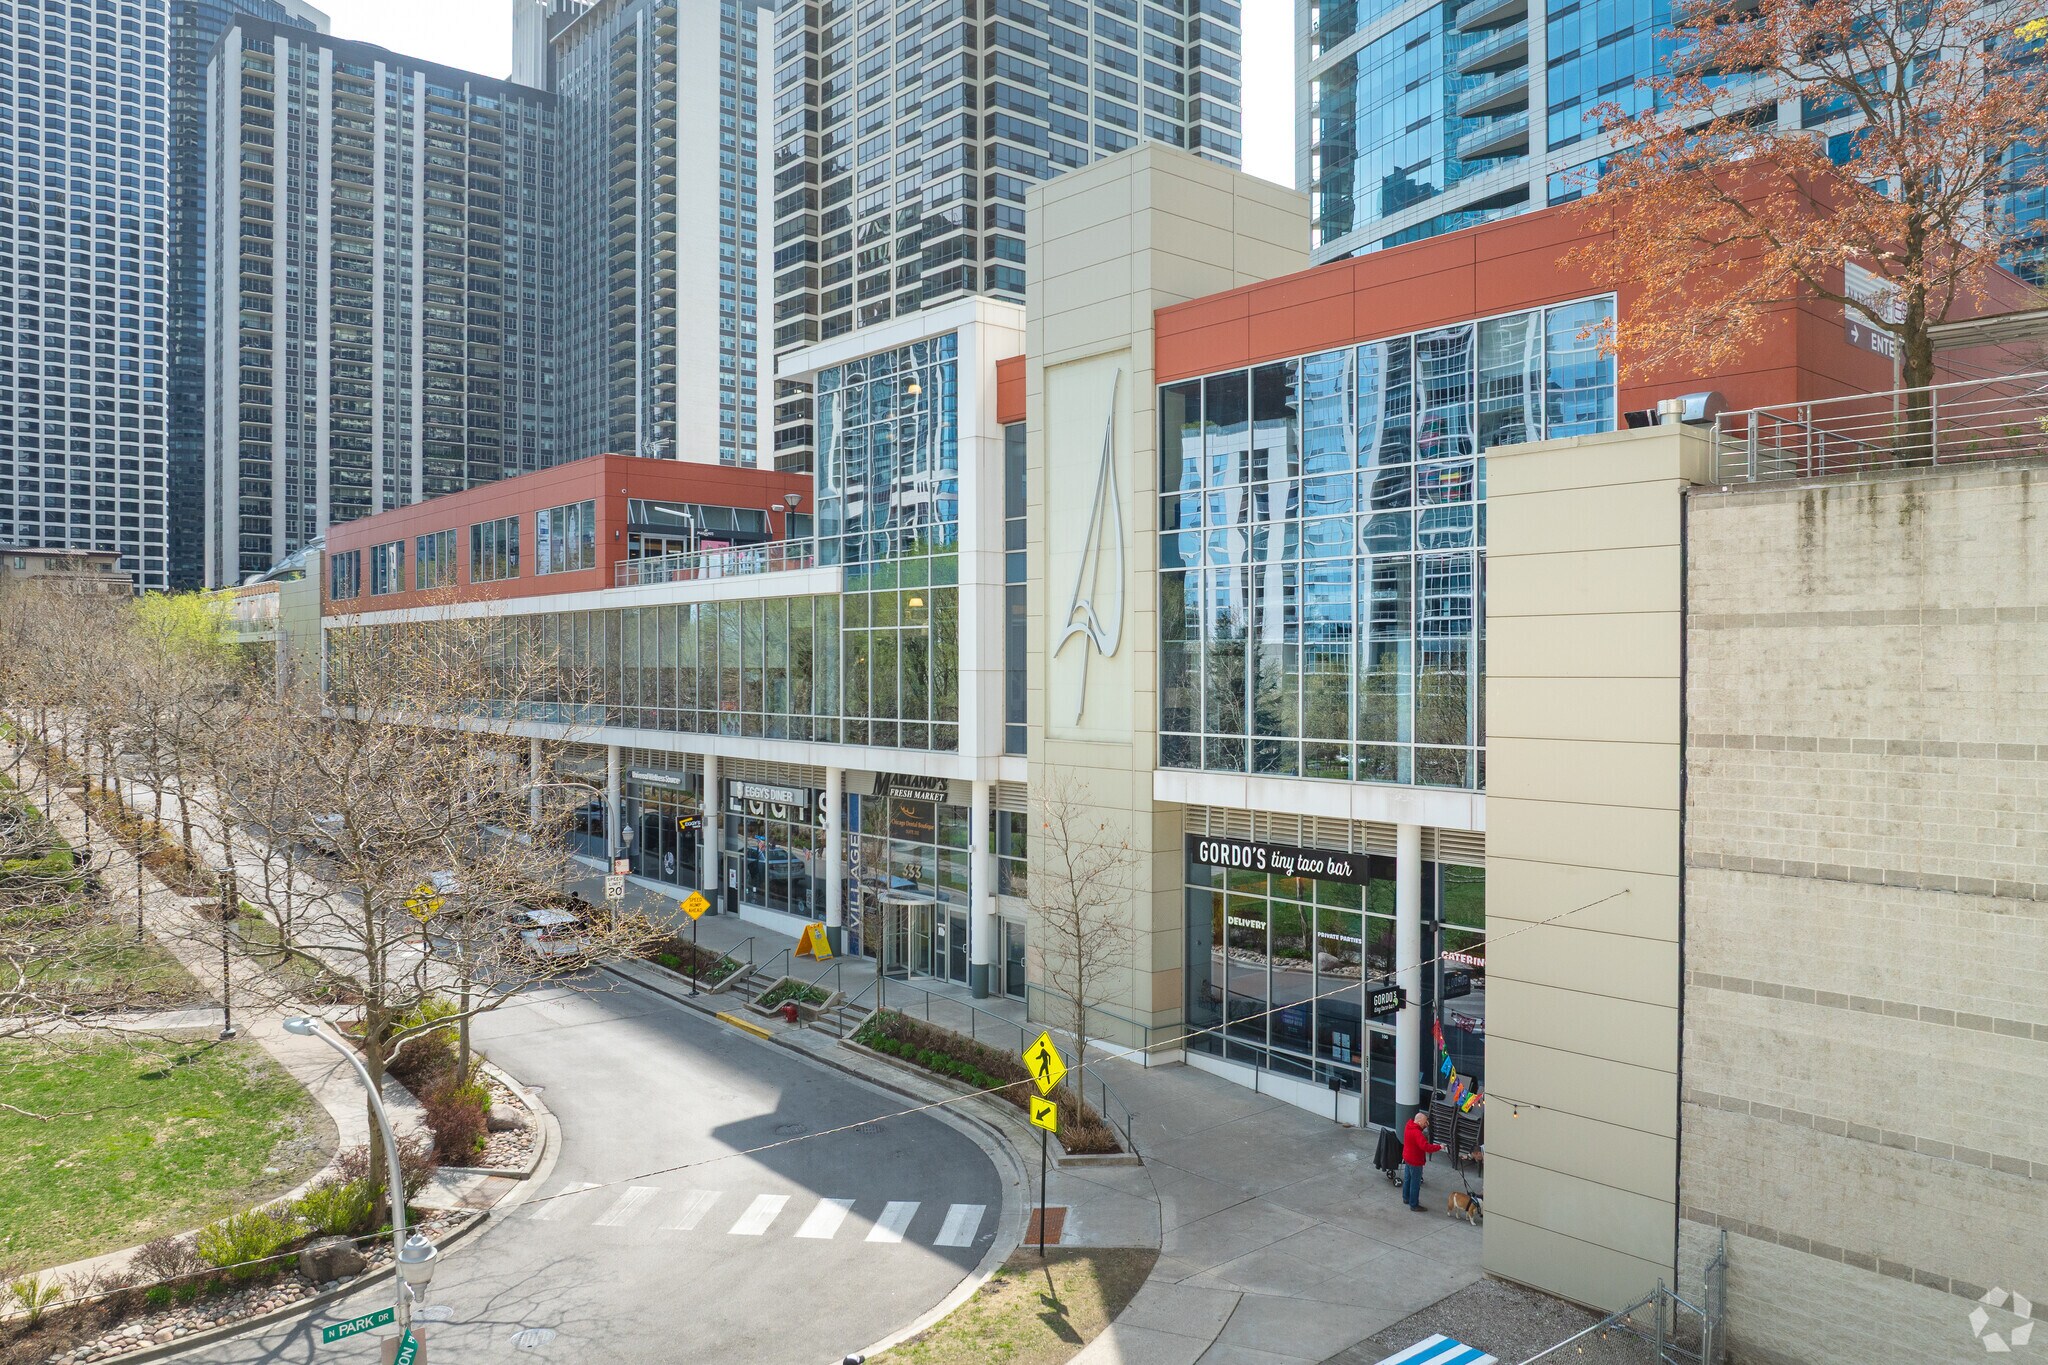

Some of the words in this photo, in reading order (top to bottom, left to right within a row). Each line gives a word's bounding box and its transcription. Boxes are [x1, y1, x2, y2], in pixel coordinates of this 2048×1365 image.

[745, 786, 770, 800] EGGY'S
[770, 789, 794, 802] DINER
[889, 788, 913, 799] FRESH
[914, 791, 945, 802] MARKET
[1199, 841, 1267, 870] GORDO'S
[1271, 851, 1295, 877] tiny
[1297, 854, 1324, 873] taco
[1326, 857, 1353, 877] bar
[850, 834, 861, 928] VILLAGE
[608, 887, 623, 897] 20
[1228, 916, 1267, 930] DELIVERY
[1317, 931, 1340, 941] PRIVATE
[1340, 935, 1362, 944] PARTIES
[1373, 990, 1397, 1006] GORDO'S
[329, 1329, 335, 1338] N
[339, 1316, 374, 1336] PARK
[378, 1313, 389, 1322] DR
